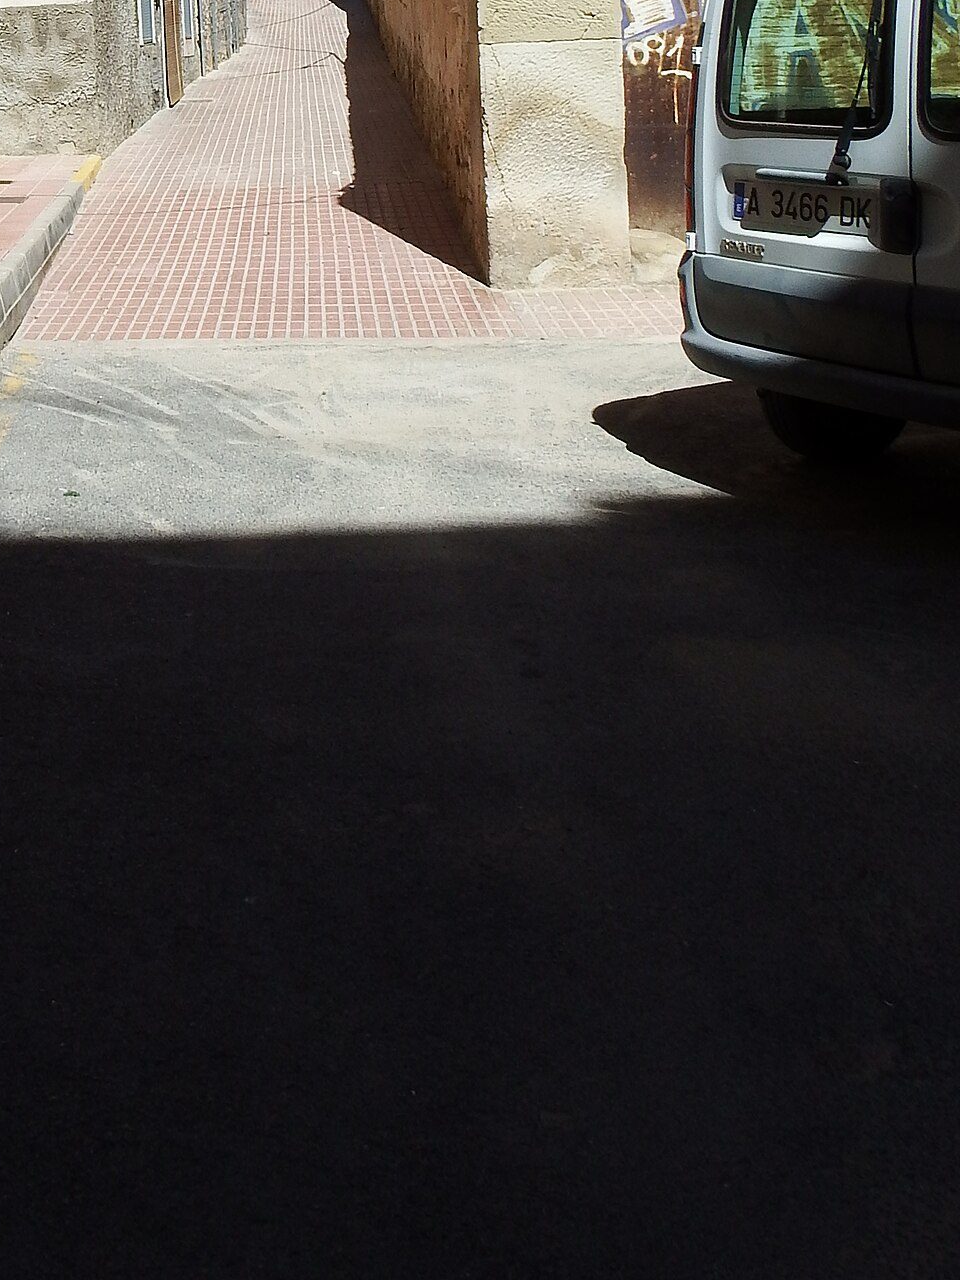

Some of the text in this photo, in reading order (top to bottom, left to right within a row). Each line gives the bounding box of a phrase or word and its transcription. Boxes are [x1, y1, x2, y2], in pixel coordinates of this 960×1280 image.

[747, 187, 872, 229] A 3466 DK
